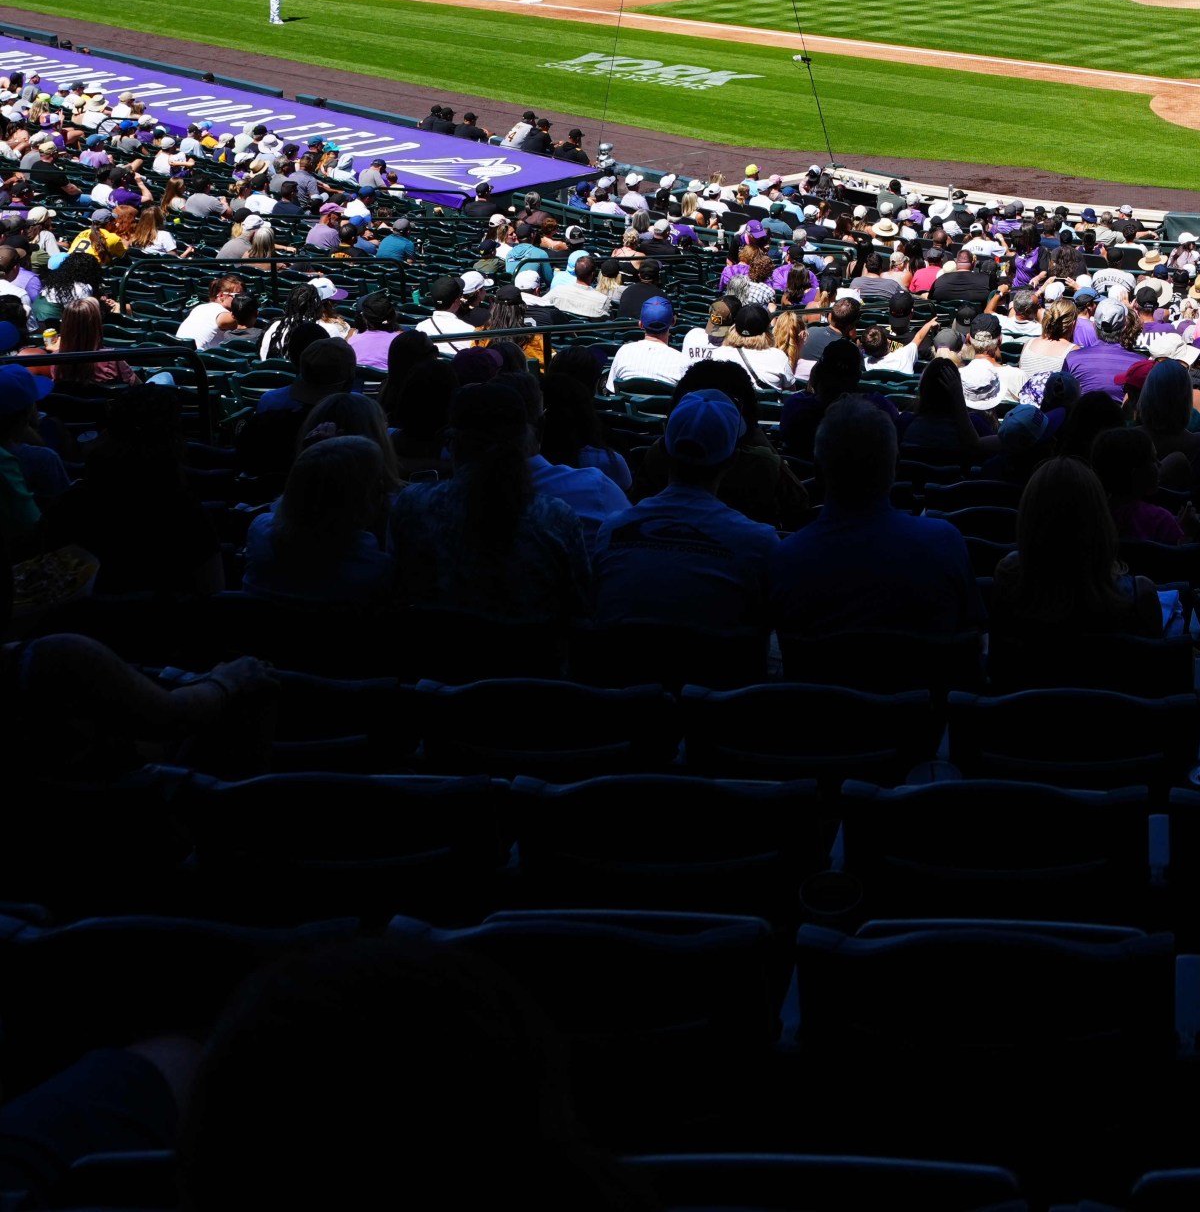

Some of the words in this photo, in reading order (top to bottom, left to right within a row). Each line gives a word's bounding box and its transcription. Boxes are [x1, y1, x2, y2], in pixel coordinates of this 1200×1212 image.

[536, 62, 605, 76] SPACE
[607, 72, 715, 90] SYSTEMS
[559, 51, 766, 86] YORK
[149, 95, 297, 128] COORS
